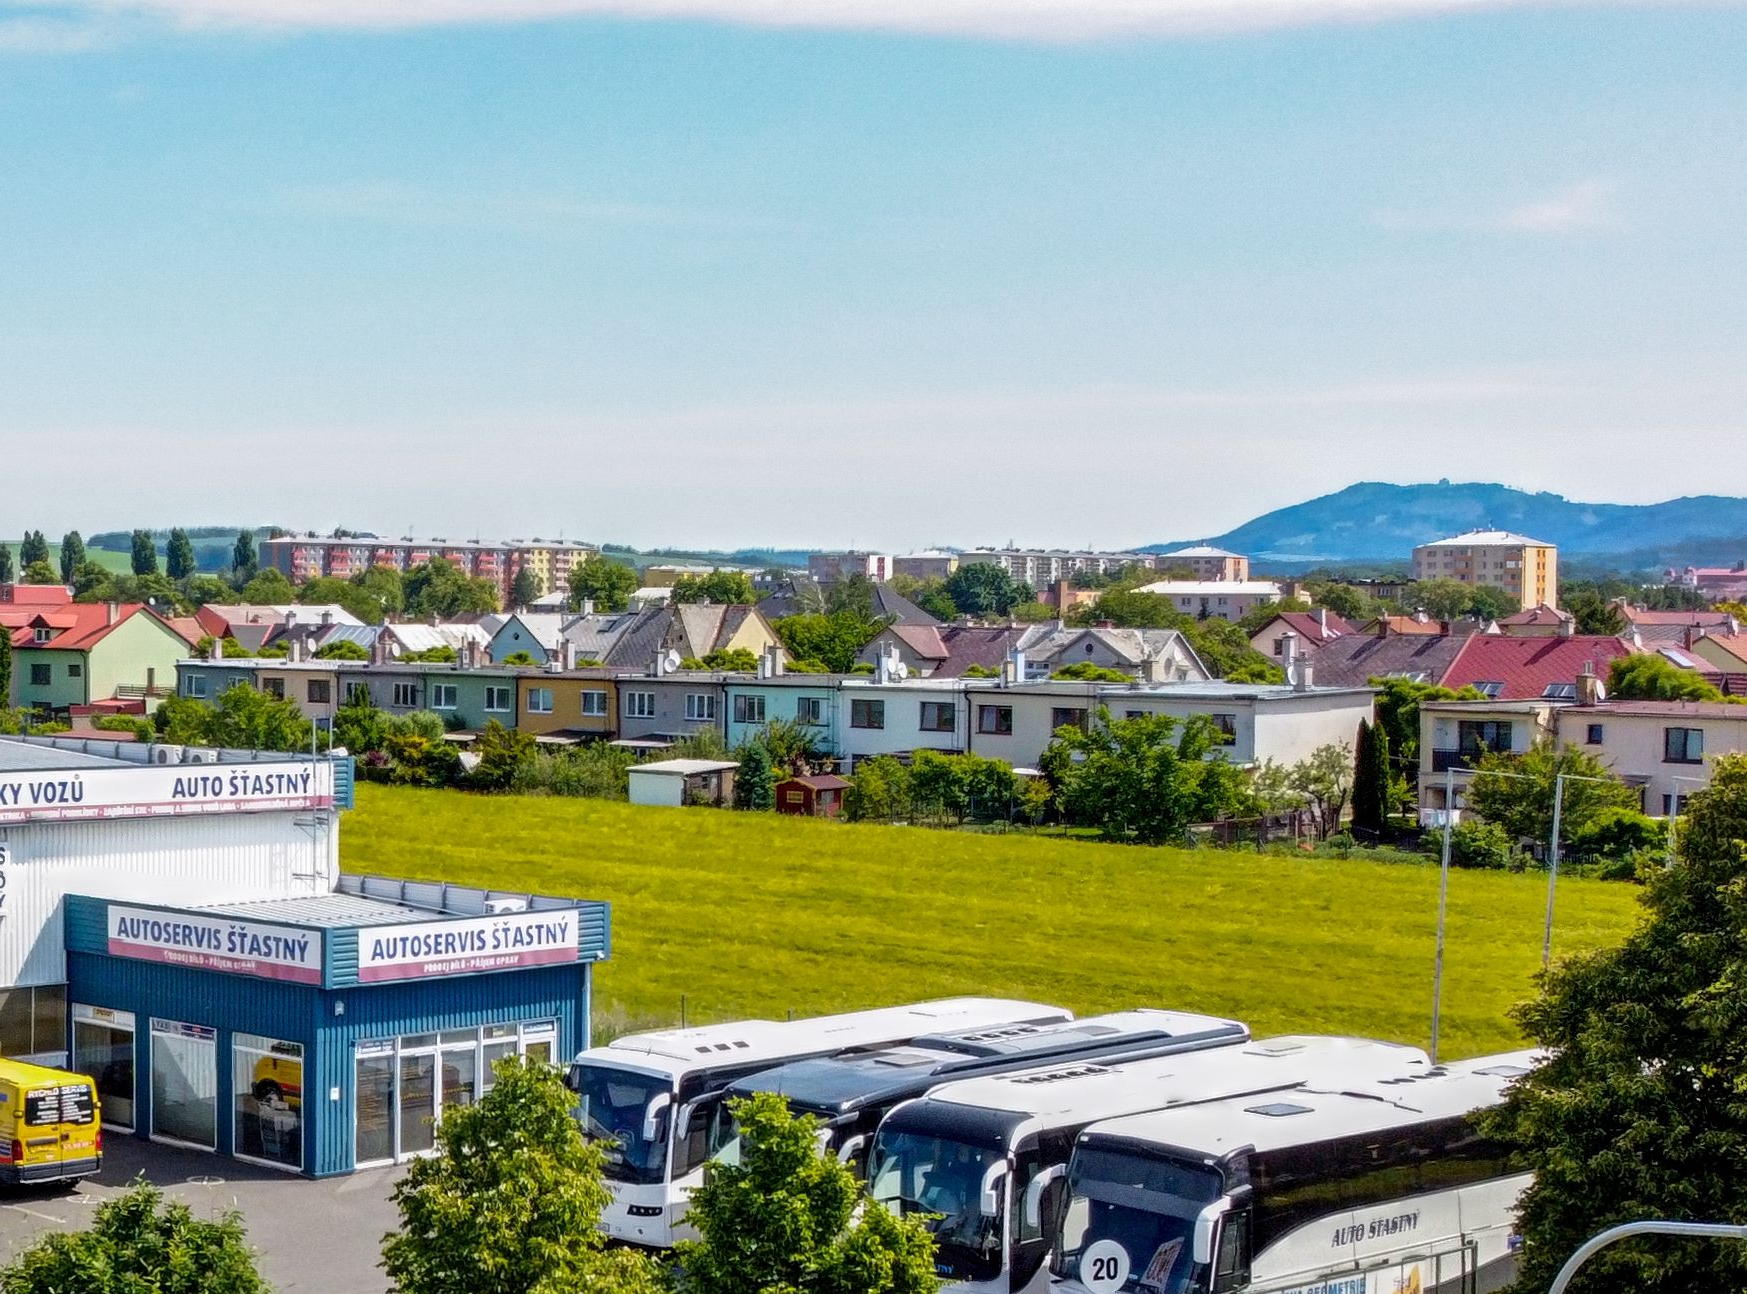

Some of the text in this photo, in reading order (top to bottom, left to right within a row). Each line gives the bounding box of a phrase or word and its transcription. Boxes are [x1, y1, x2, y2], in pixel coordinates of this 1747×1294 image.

[29, 773, 85, 804] VOZŮ
[171, 767, 311, 799] AUTO ŠŤASTNÝ
[117, 916, 309, 963] AUTOSERVIS ŠŤASTNÝ
[371, 914, 569, 961] AUTOSERVIS ŠŤASTNÝ
[1331, 1223, 1365, 1248] AUTO
[1092, 1256, 1119, 1282] 20
